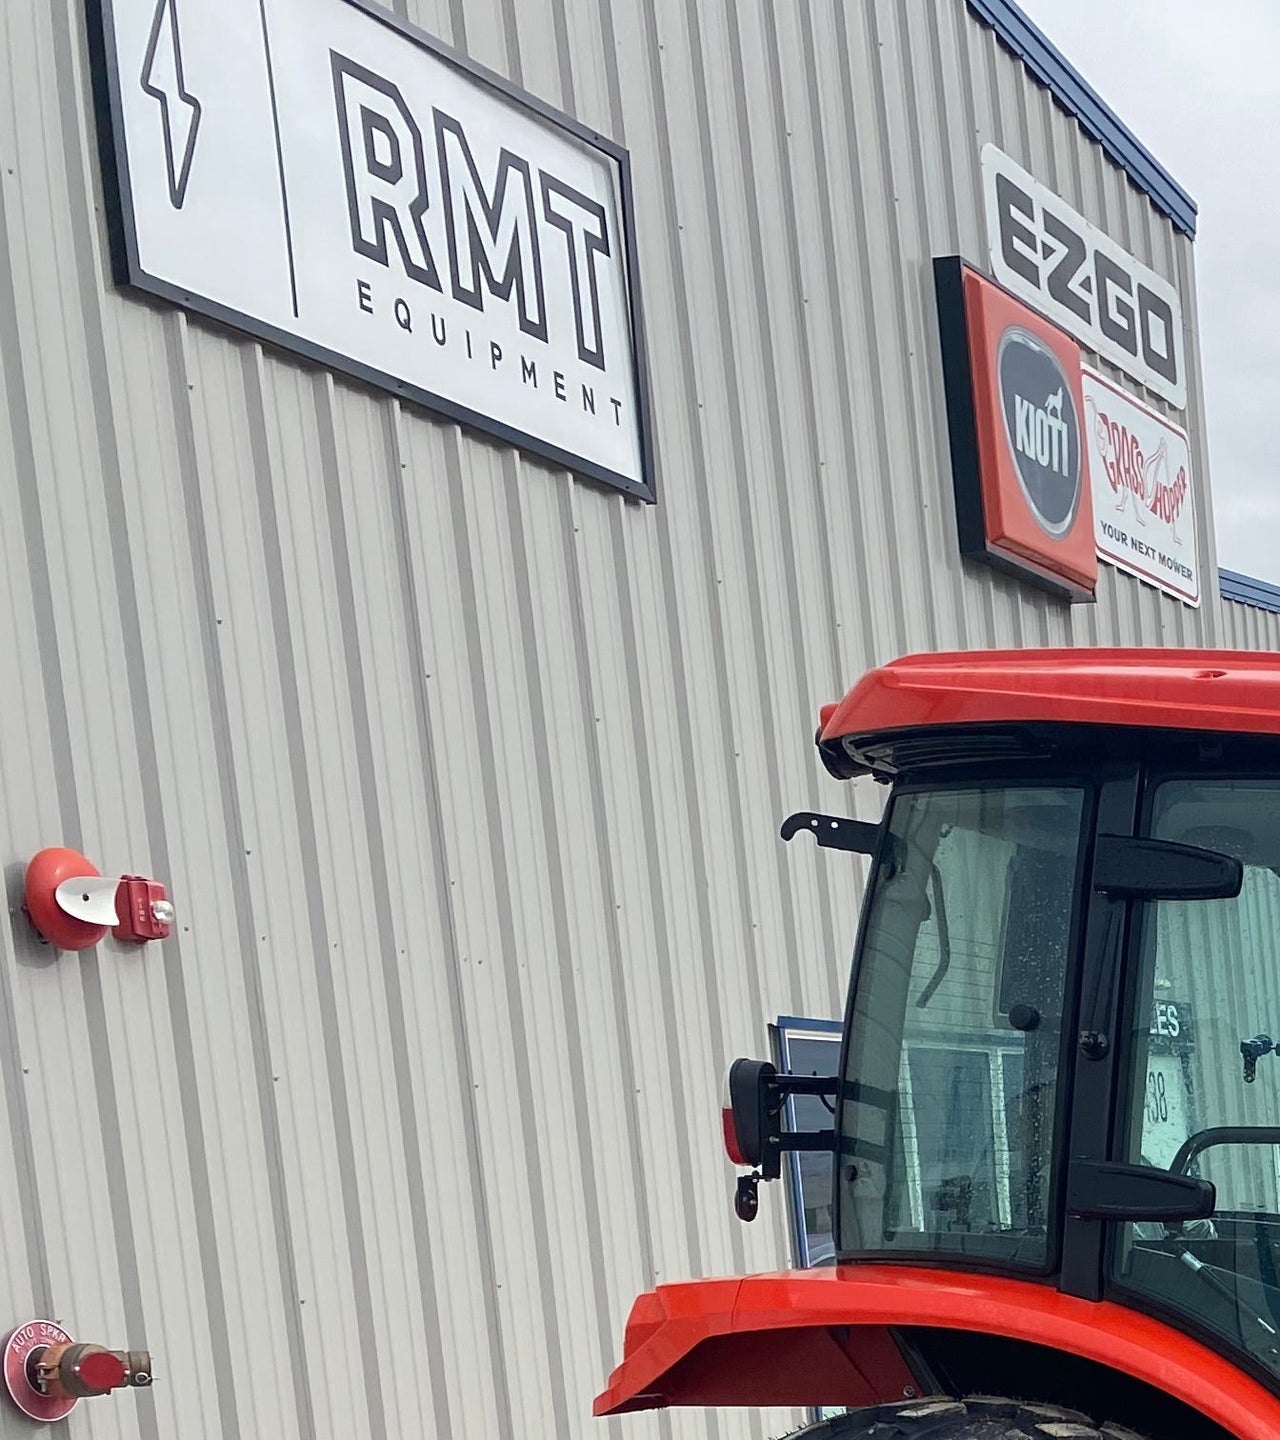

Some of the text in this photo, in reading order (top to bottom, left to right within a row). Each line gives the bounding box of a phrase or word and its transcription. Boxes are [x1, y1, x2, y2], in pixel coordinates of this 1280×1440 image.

[329, 48, 611, 372] RMT
[356, 278, 622, 426] EQUIPMENT
[1014, 393, 1069, 478] KIOTI
[1100, 519, 1193, 582] YOUR NEXT MOWER
[12, 1326, 34, 1354] AUTO
